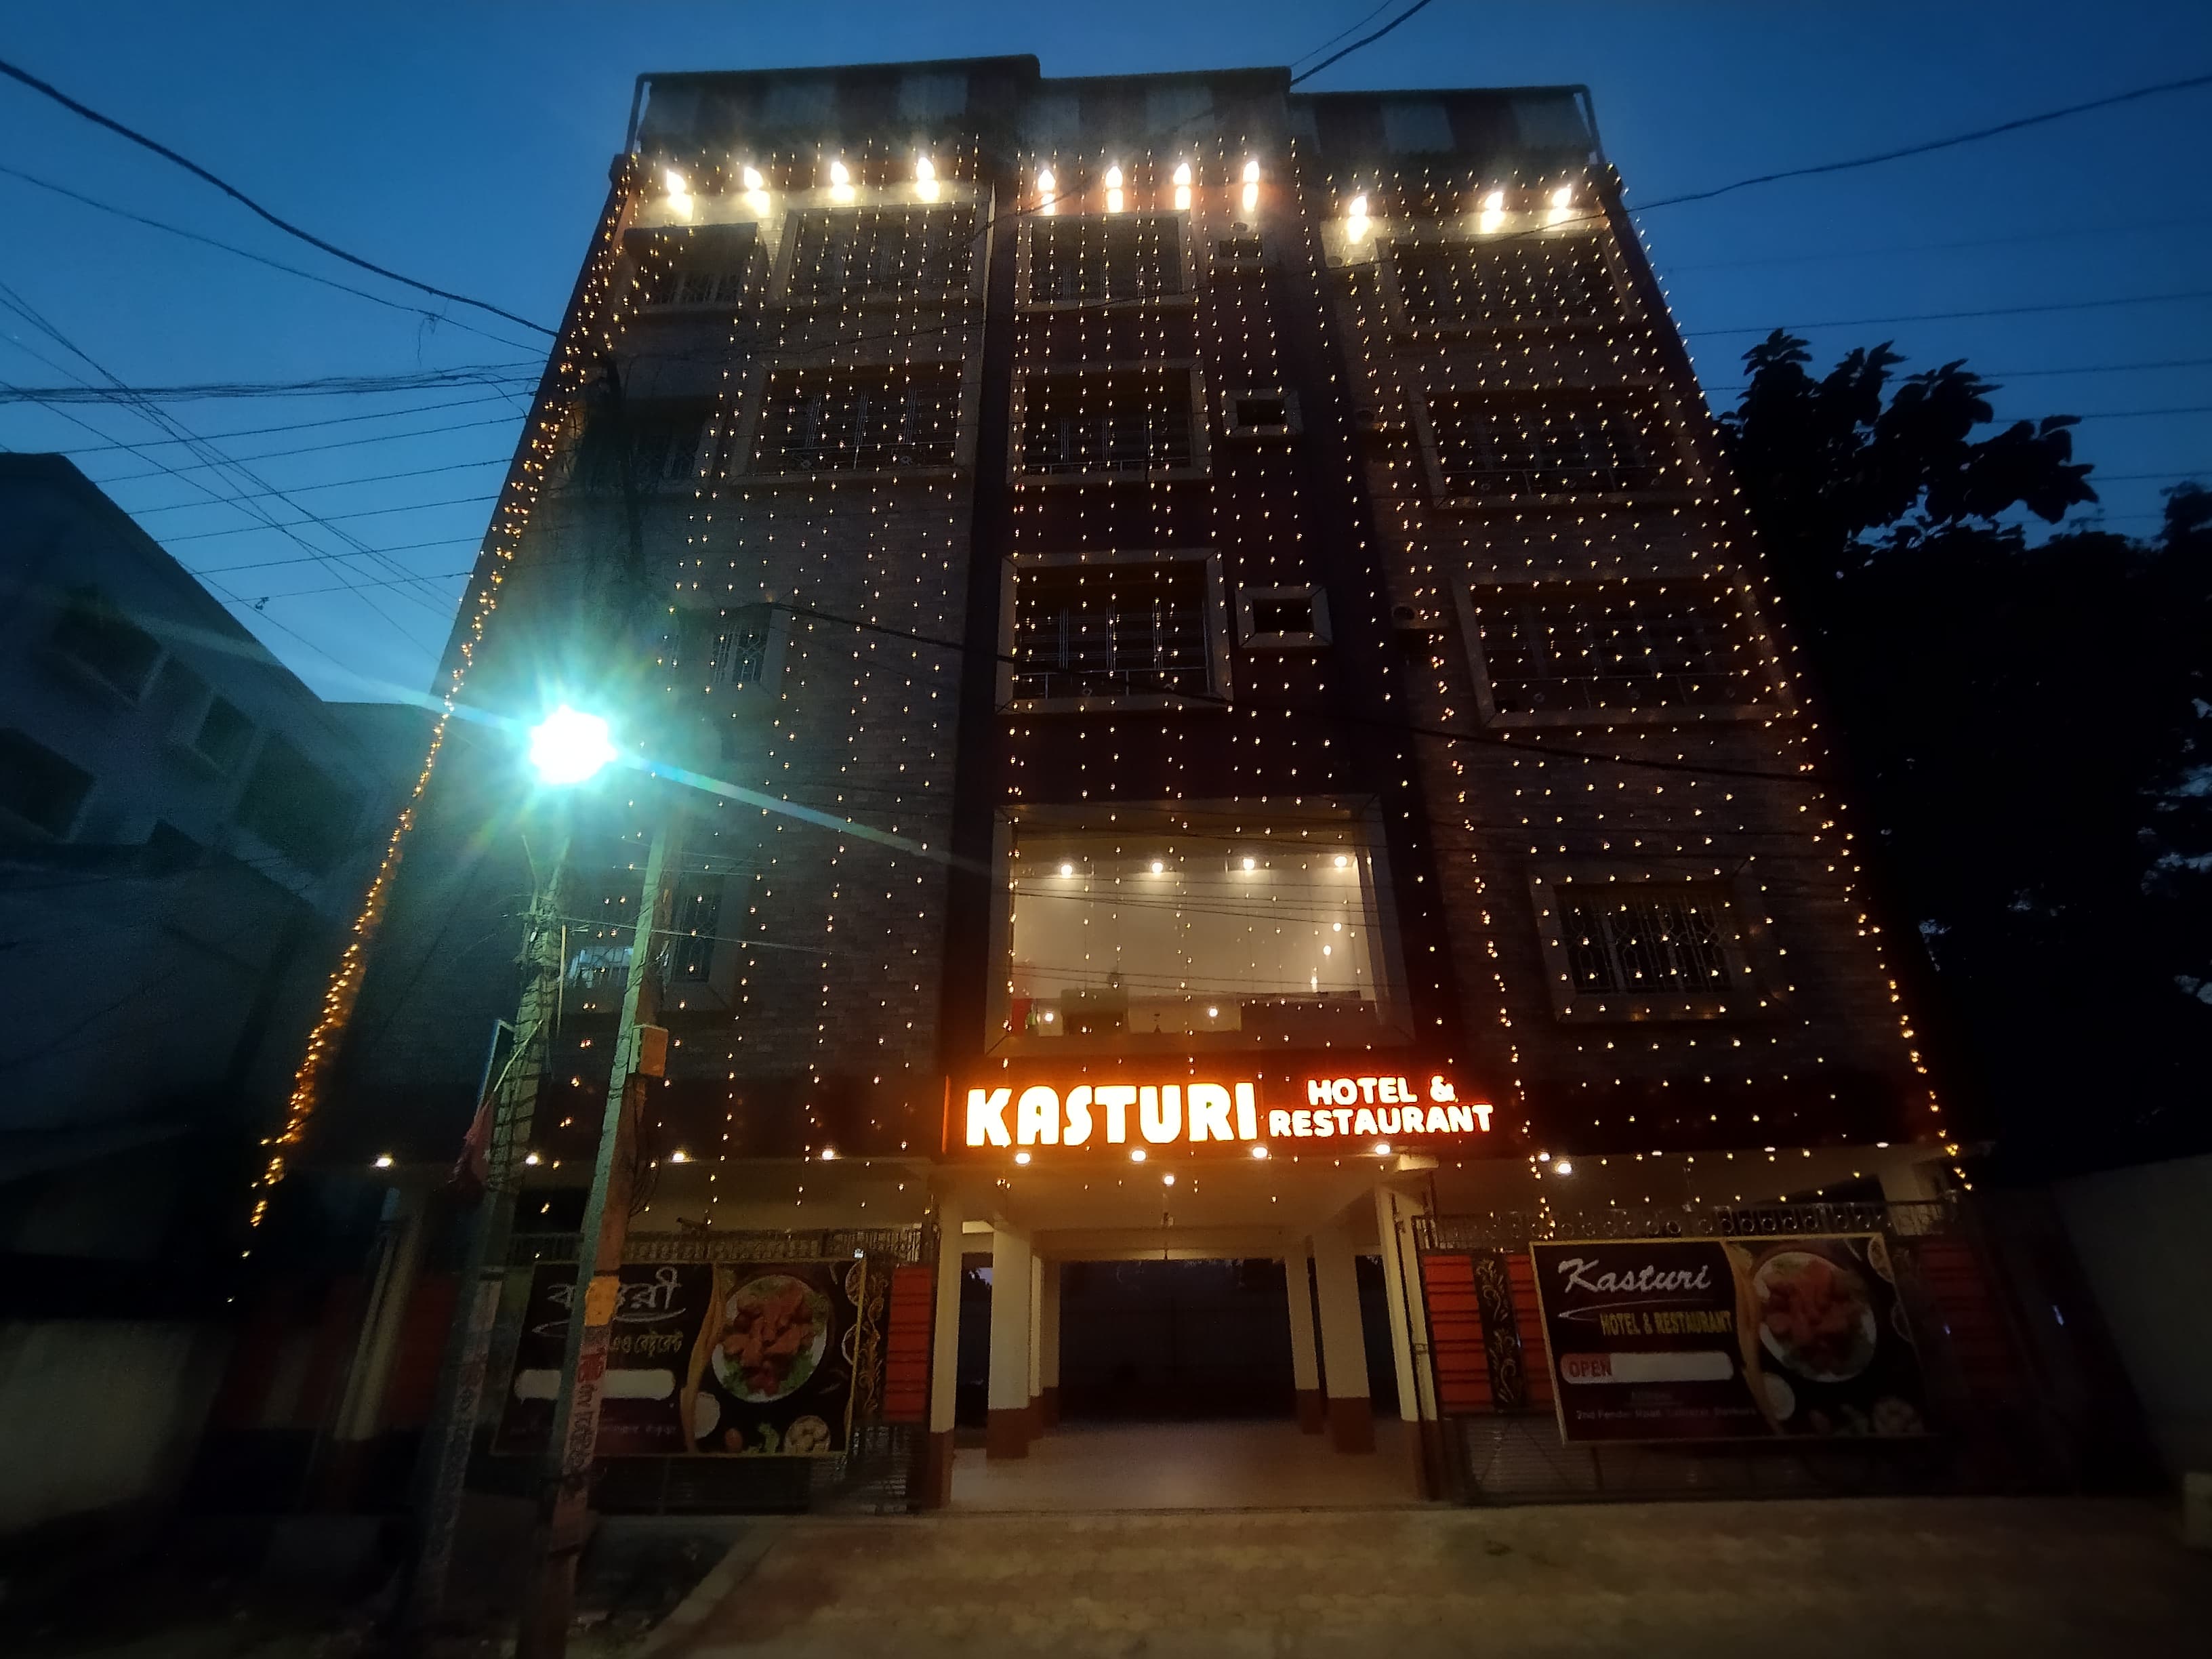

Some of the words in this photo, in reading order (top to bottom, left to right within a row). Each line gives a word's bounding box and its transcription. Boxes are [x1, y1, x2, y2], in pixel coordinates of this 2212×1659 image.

[1308, 1077, 1418, 1106] HOTEL
[1429, 1076, 1456, 1103] &
[966, 1082, 1258, 1147] KASTURI
[1269, 1104, 1494, 1137] RESTAURANT
[1558, 1258, 1712, 1293] Kasturi
[1599, 1312, 1641, 1336] HOTEL
[1653, 1311, 1734, 1334] RESTAURANT
[1569, 1359, 1612, 1378] OPEN
